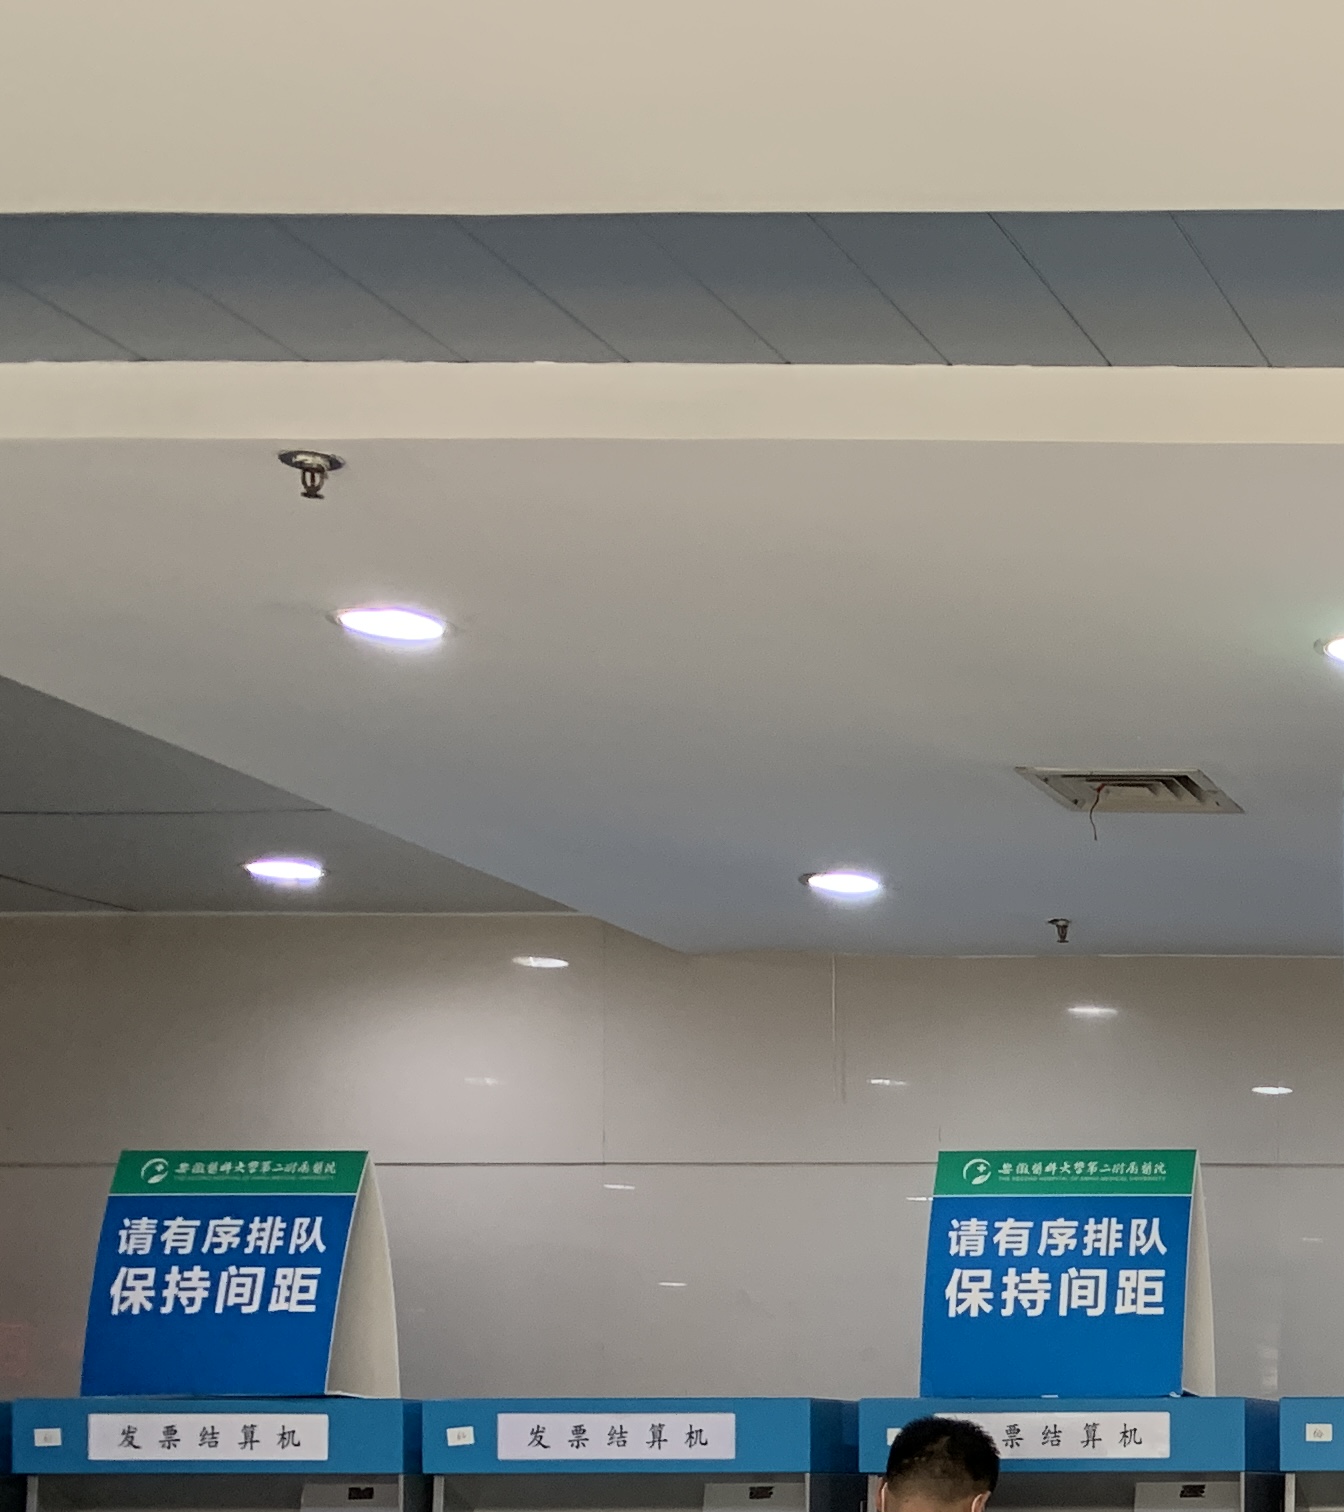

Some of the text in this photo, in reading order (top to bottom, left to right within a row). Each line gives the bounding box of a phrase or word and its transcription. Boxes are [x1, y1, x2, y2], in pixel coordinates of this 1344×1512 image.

[117, 1215, 327, 1256] 请有序排队
[947, 1217, 1168, 1257] 请有序排队
[109, 1265, 322, 1316] 保持间距
[944, 1266, 1166, 1318] 保持间距
[118, 1423, 301, 1451] 发票结算机
[527, 1422, 709, 1451] 发票结算机
[1001, 1422, 1143, 1450] 票结算机
